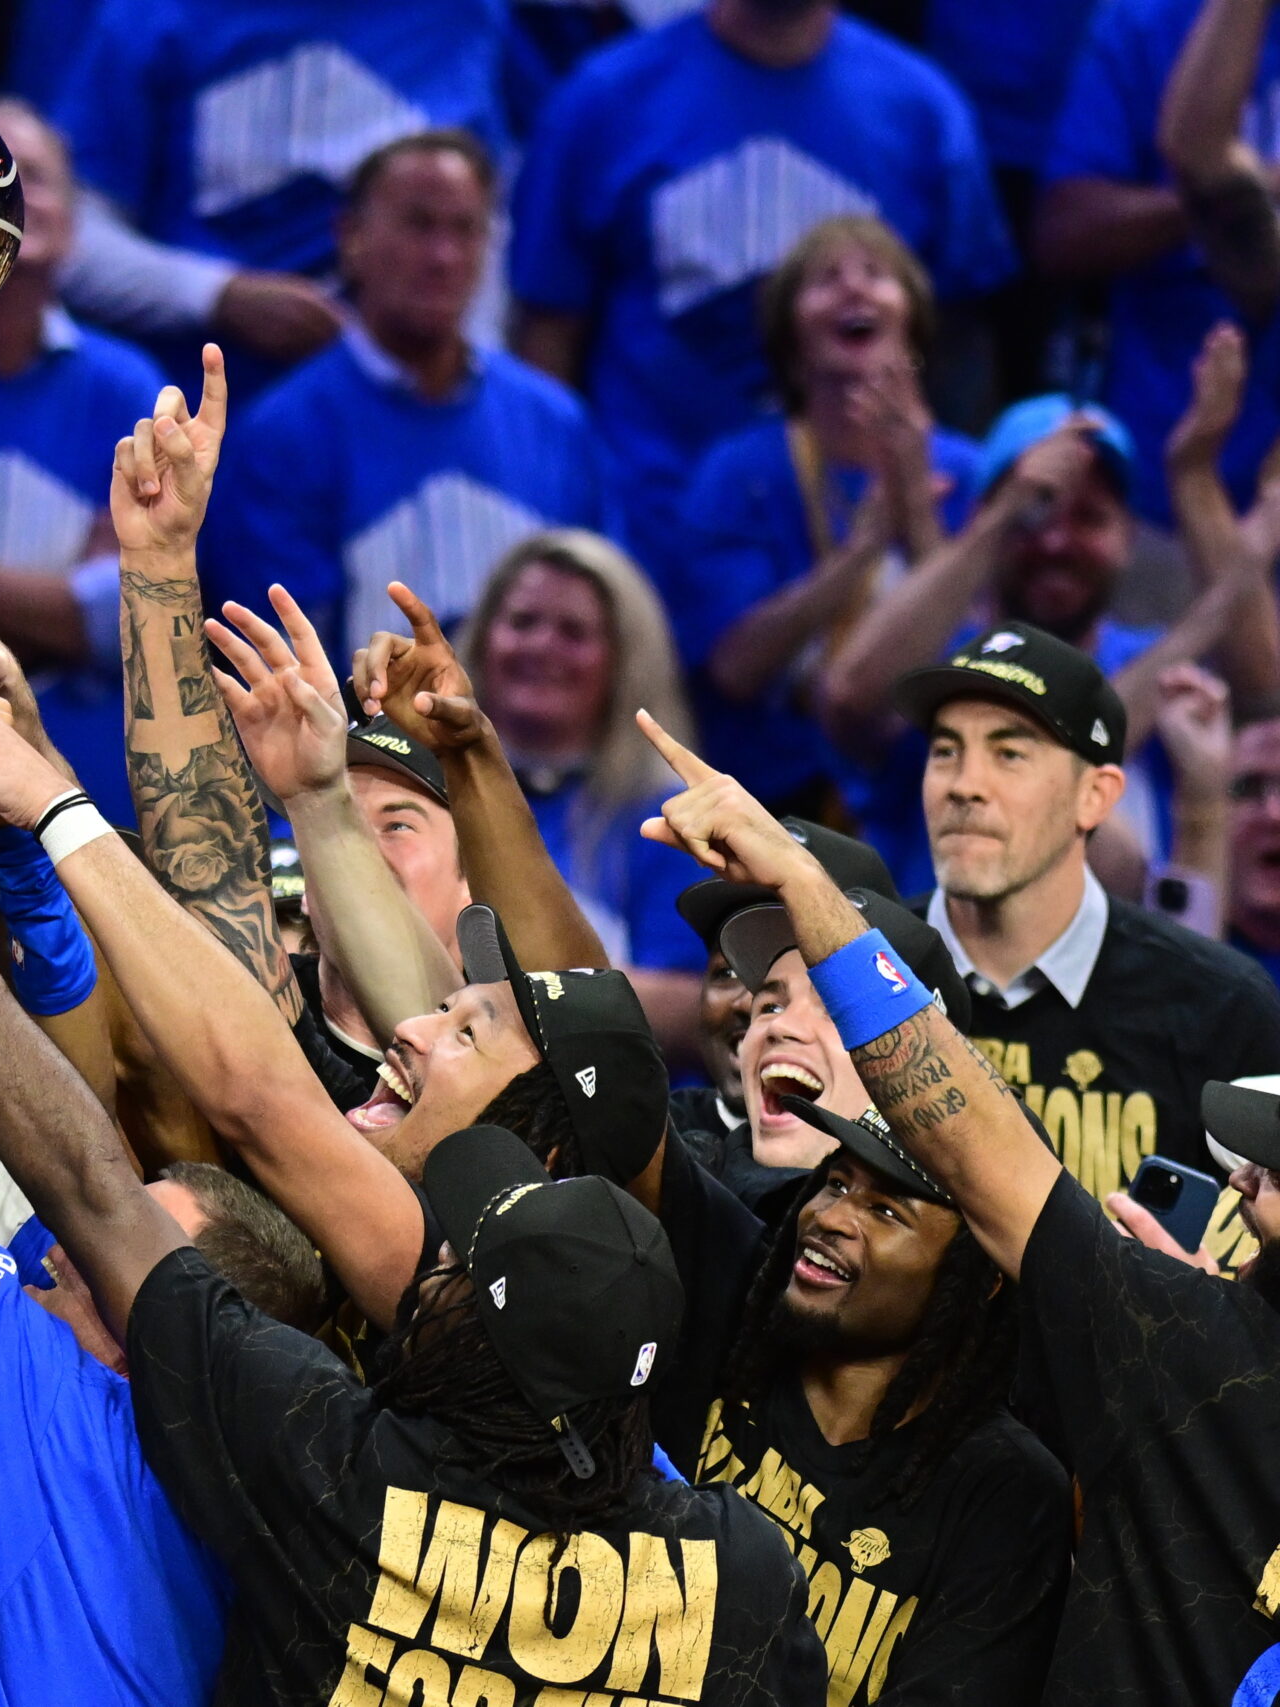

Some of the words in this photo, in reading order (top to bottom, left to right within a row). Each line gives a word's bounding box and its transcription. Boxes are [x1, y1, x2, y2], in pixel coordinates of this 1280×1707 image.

[172, 610, 196, 637] IV
[912, 1086, 967, 1130] GRIND
[745, 1446, 826, 1540] NBA
[367, 1485, 718, 1702] WON
